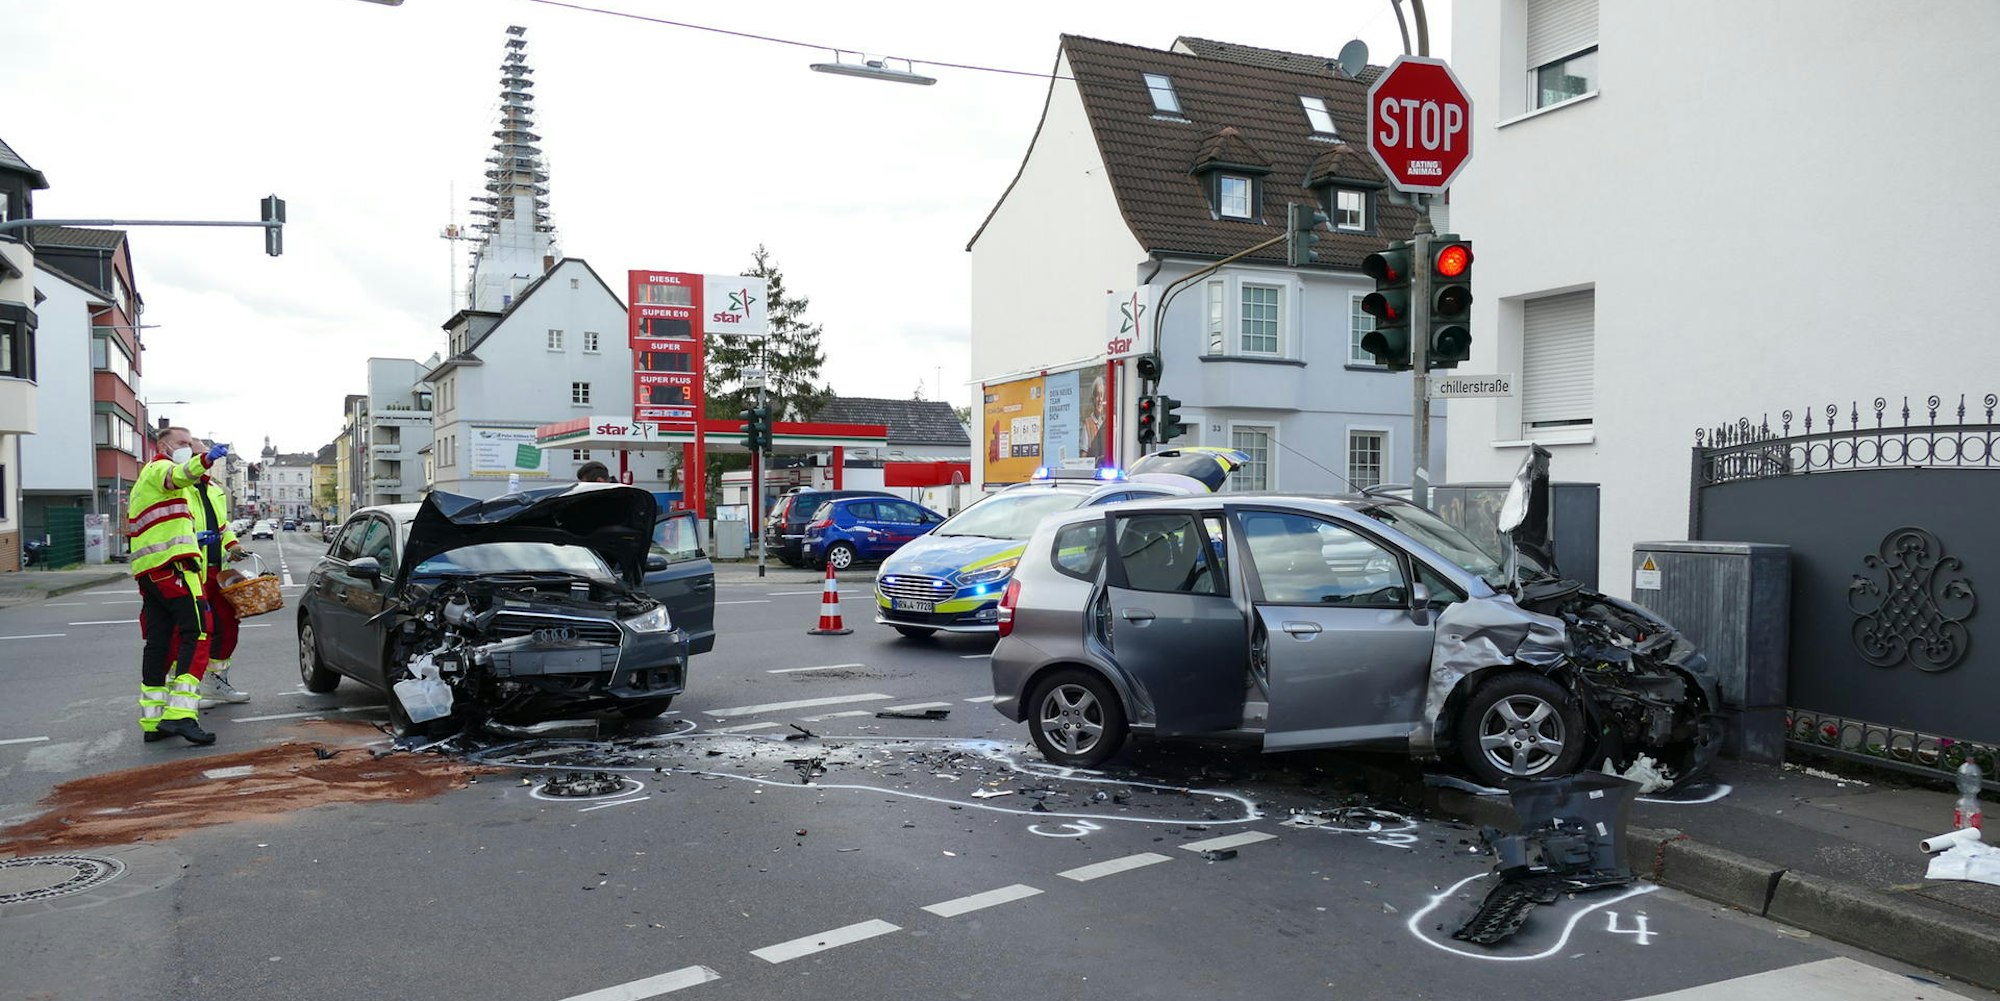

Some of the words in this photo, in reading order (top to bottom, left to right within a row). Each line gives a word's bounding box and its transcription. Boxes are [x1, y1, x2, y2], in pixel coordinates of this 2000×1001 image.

[1379, 97, 1463, 151] STOP
[1410, 160, 1439, 169] EATING
[1407, 168, 1442, 176] ANIMALS
[649, 275, 681, 284] DIESEL
[642, 308, 672, 318] SUPER
[673, 309, 689, 318] E10
[713, 310, 742, 324] star
[651, 342, 681, 351] SUPER
[1107, 336, 1132, 355] star
[640, 376, 669, 384] SUPER
[670, 376, 691, 385] PLUS
[596, 423, 628, 436] star
[1212, 424, 1221, 432] 33
[1605, 910, 1659, 946] 4
